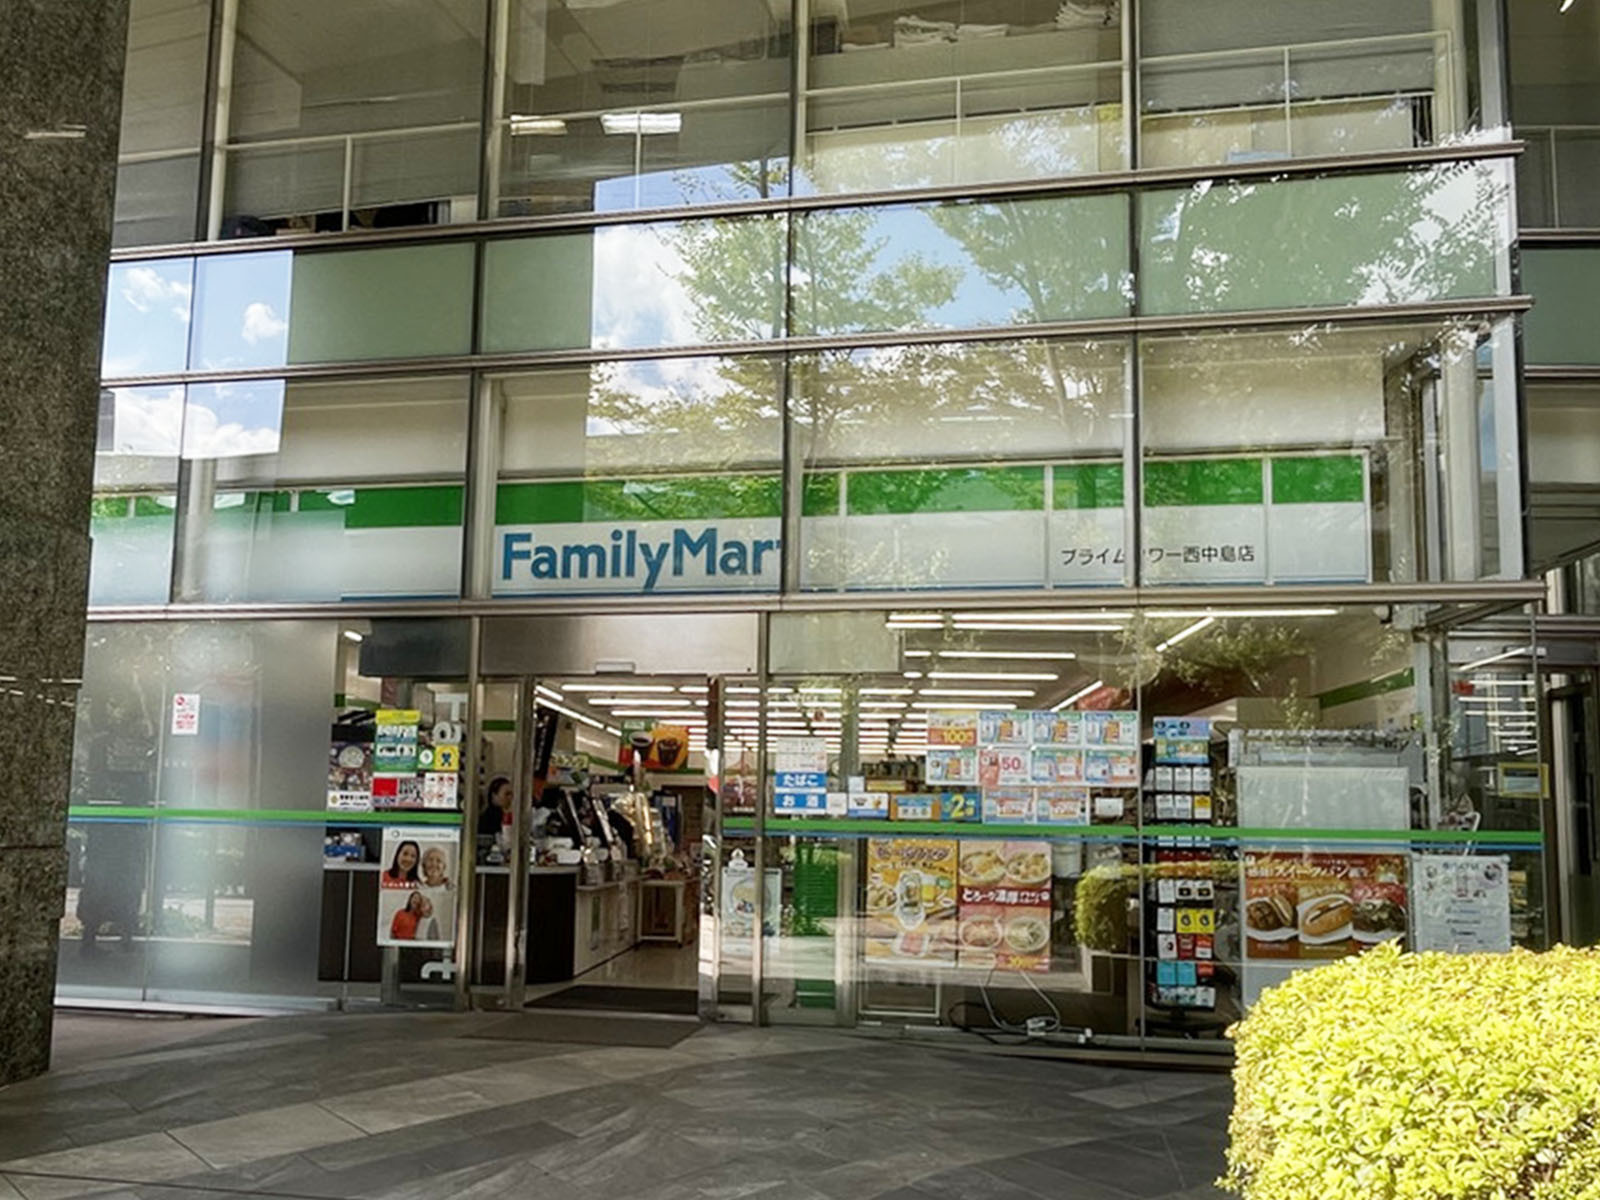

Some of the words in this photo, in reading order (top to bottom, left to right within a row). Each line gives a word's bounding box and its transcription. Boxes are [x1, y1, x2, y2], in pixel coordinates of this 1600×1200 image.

[1061, 545, 1255, 566] プライムワー西中島店
[783, 774, 819, 787] たばこ
